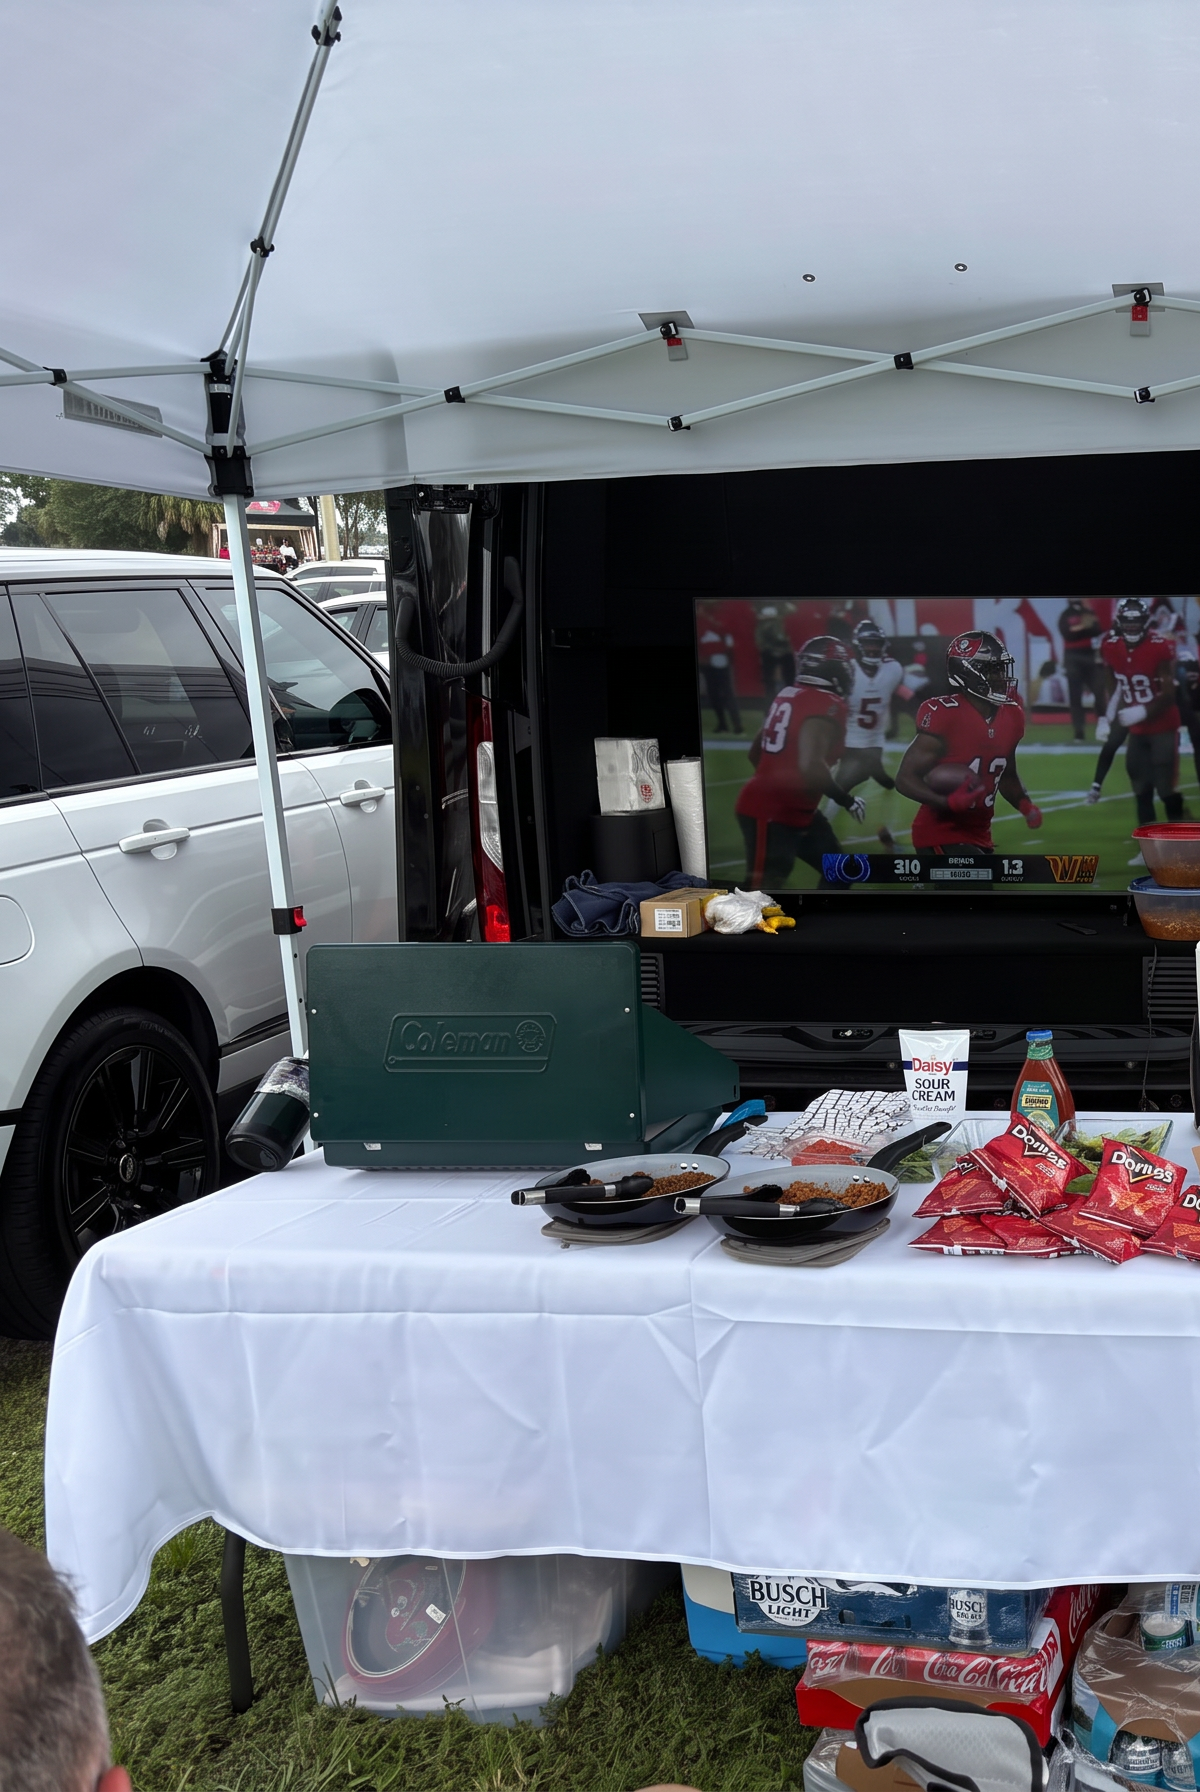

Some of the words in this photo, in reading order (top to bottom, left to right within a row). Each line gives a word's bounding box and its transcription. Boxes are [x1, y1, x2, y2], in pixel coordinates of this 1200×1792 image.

[857, 697, 882, 730] 5
[401, 1020, 512, 1053] Coleman
[912, 1057, 953, 1076] Daisy
[915, 1077, 951, 1090] SOUR
[911, 1090, 956, 1102] CREAM
[750, 1580, 826, 1608] BUSCH
[768, 1604, 812, 1618] LIGHT
